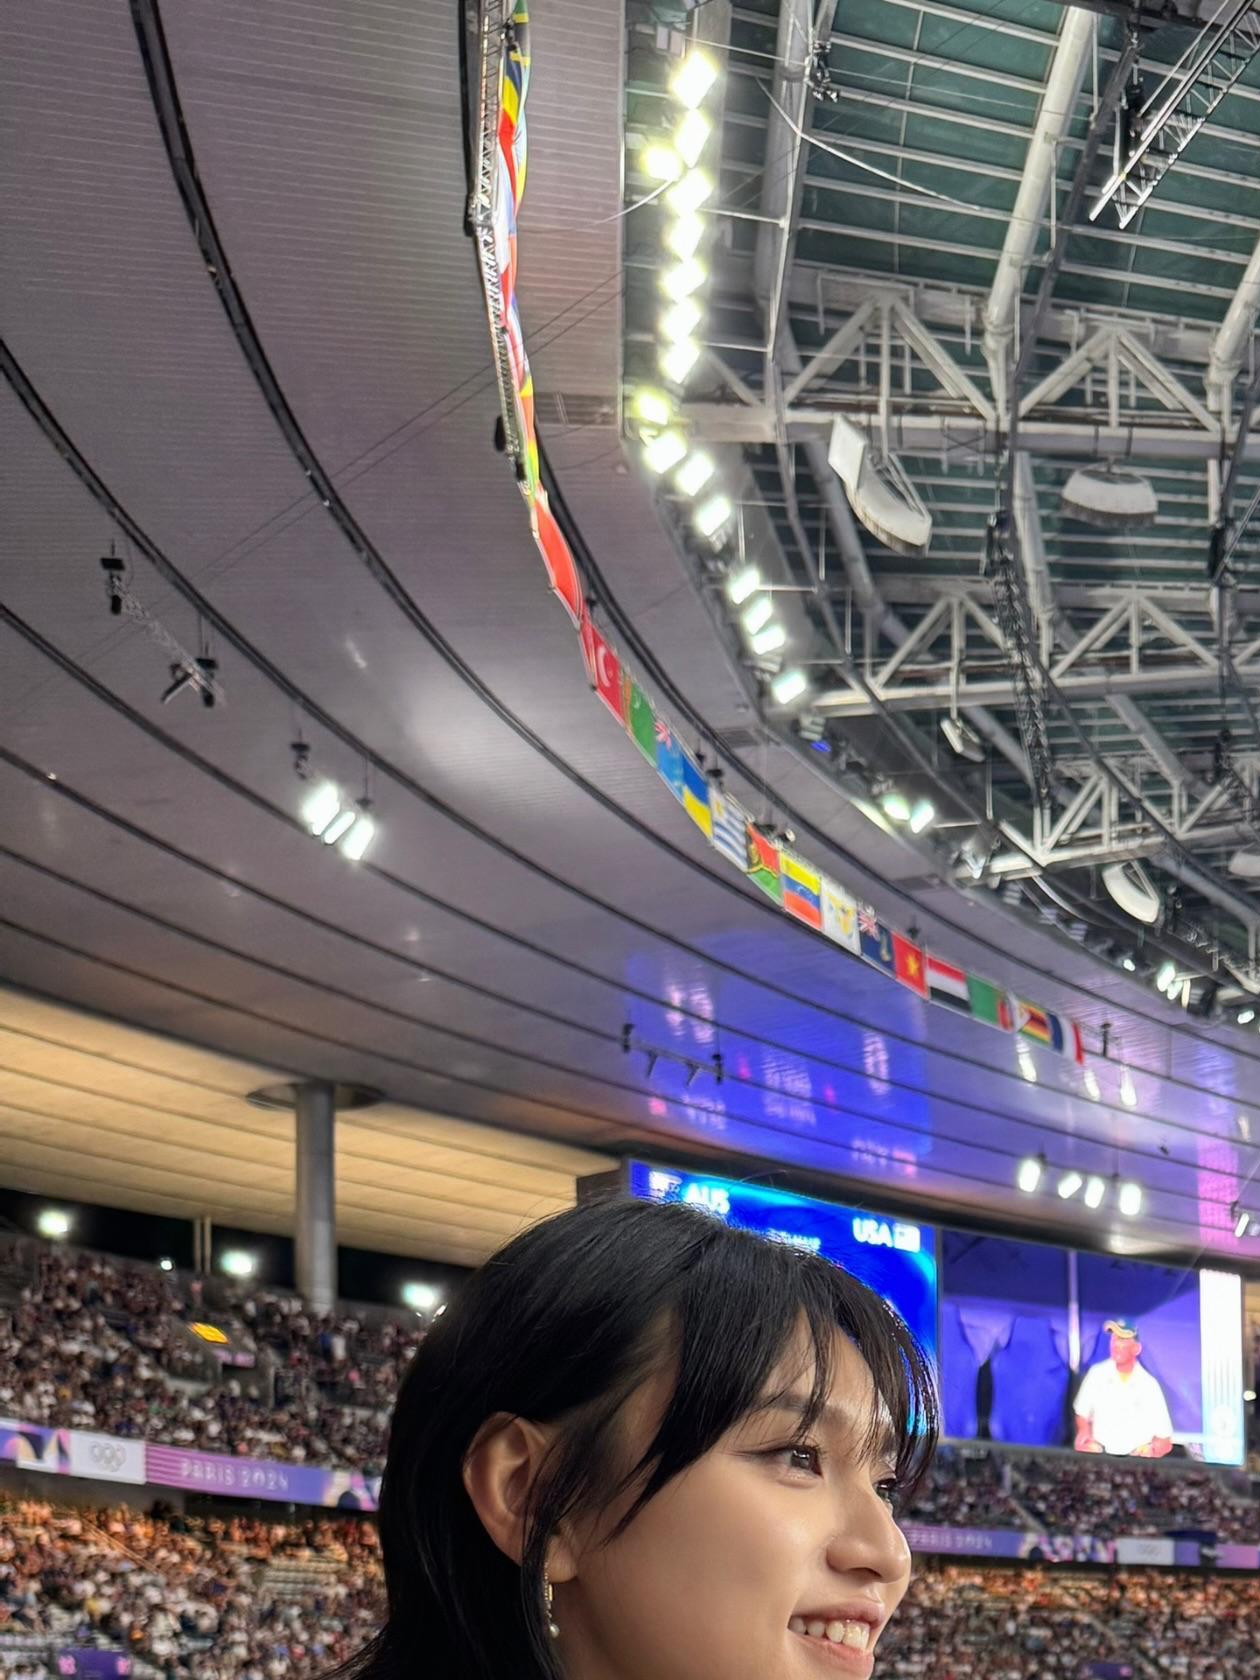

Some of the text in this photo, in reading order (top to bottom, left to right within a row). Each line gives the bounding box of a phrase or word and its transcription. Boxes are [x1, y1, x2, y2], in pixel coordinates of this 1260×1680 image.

[852, 1216, 894, 1248] USA
[181, 1458, 289, 1491] PARIS 2024
